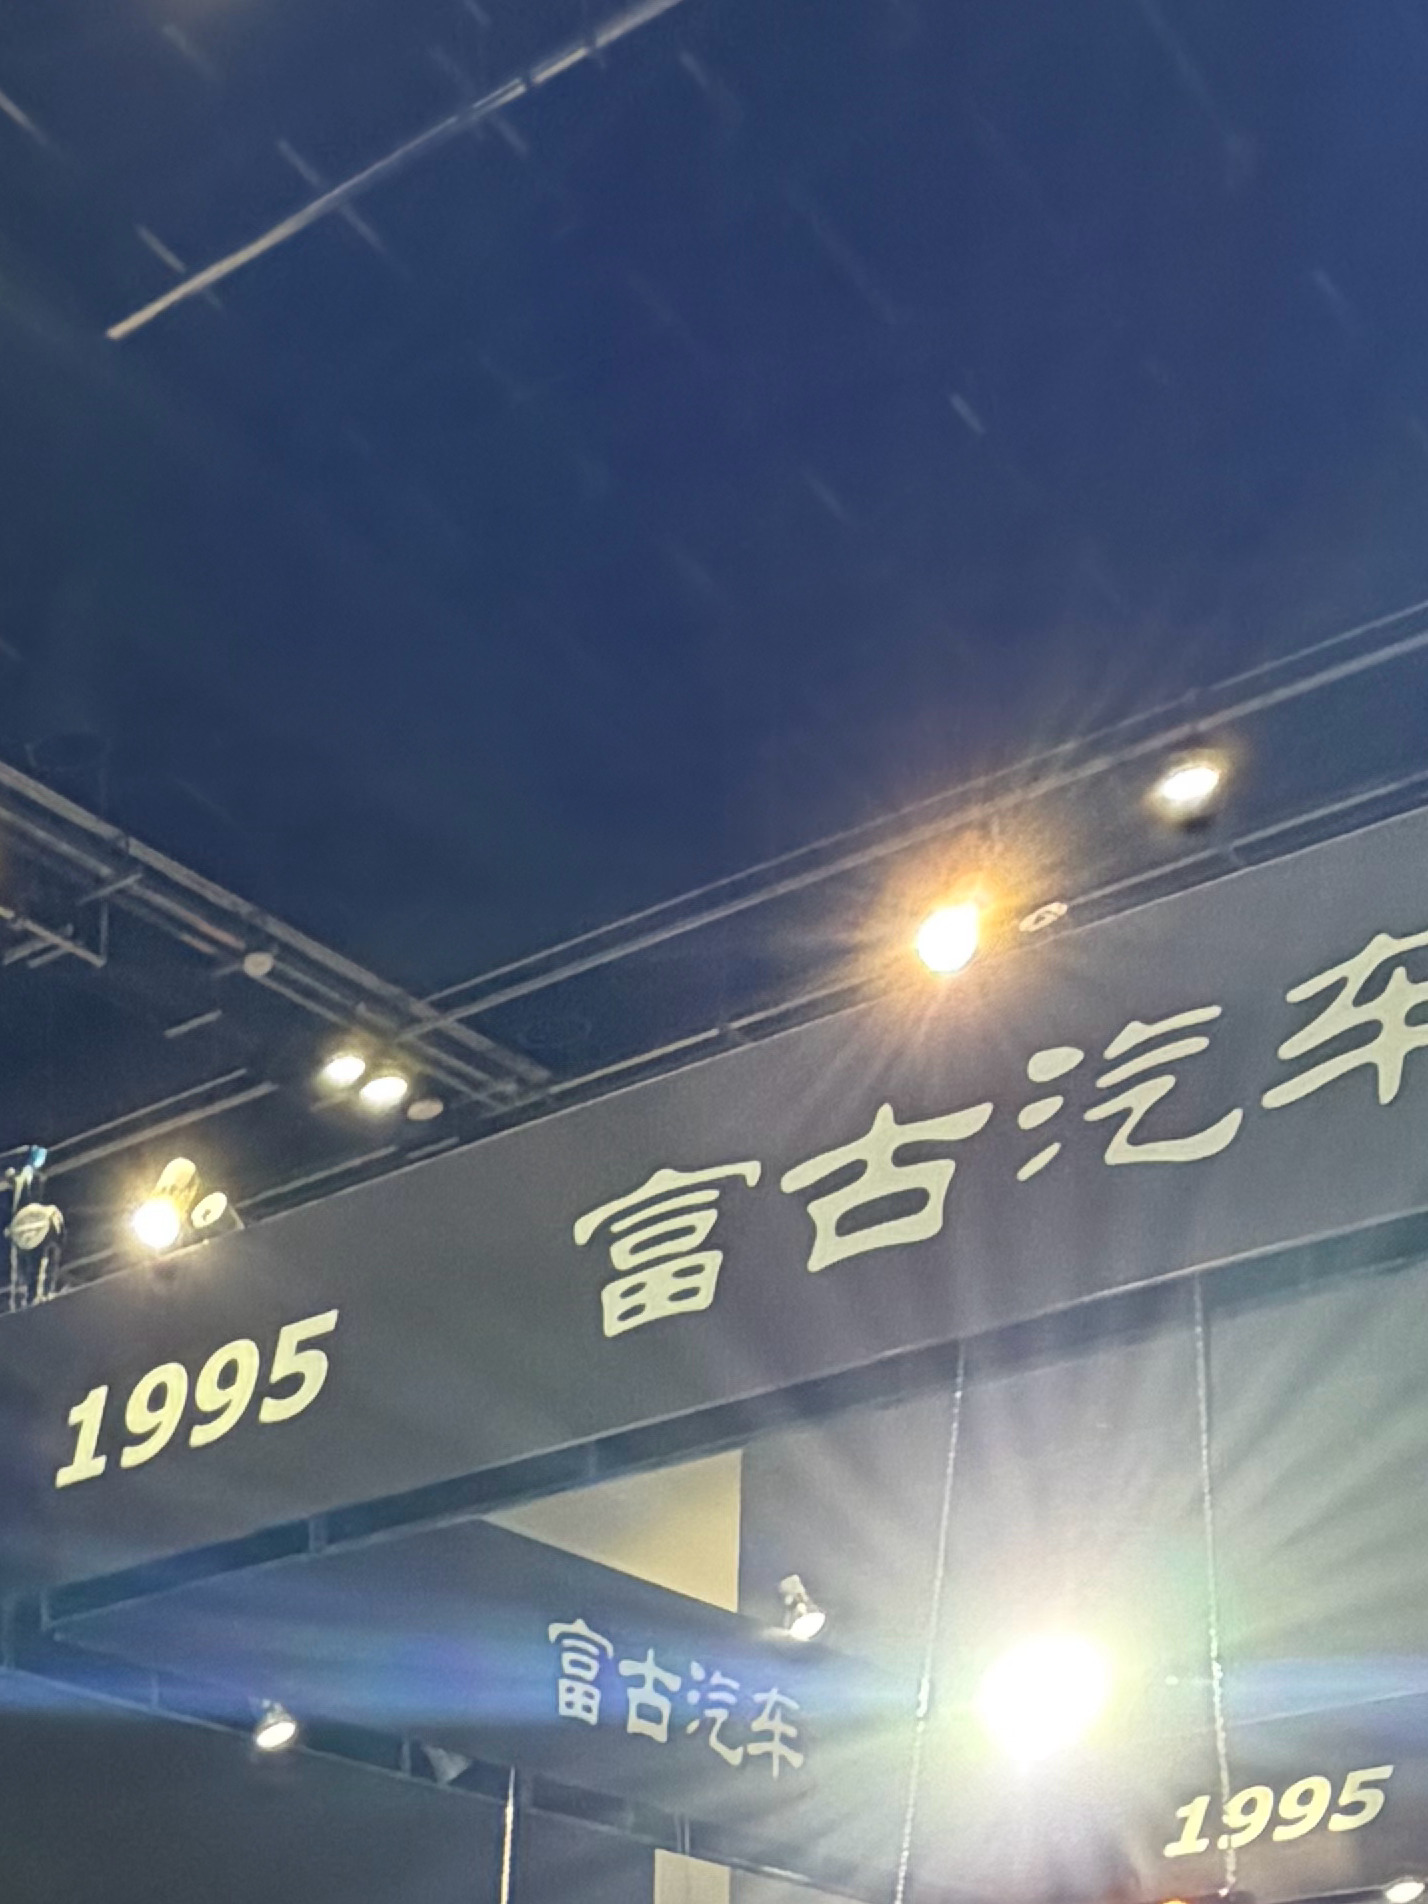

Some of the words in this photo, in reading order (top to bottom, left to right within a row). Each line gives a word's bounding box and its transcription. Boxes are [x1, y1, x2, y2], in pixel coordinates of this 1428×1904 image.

[55, 1308, 339, 1488] 1995
[573, 932, 1428, 1337] 富古汽车
[548, 1618, 805, 1778] 富古汽车
[1162, 1764, 1394, 1858] 1995
